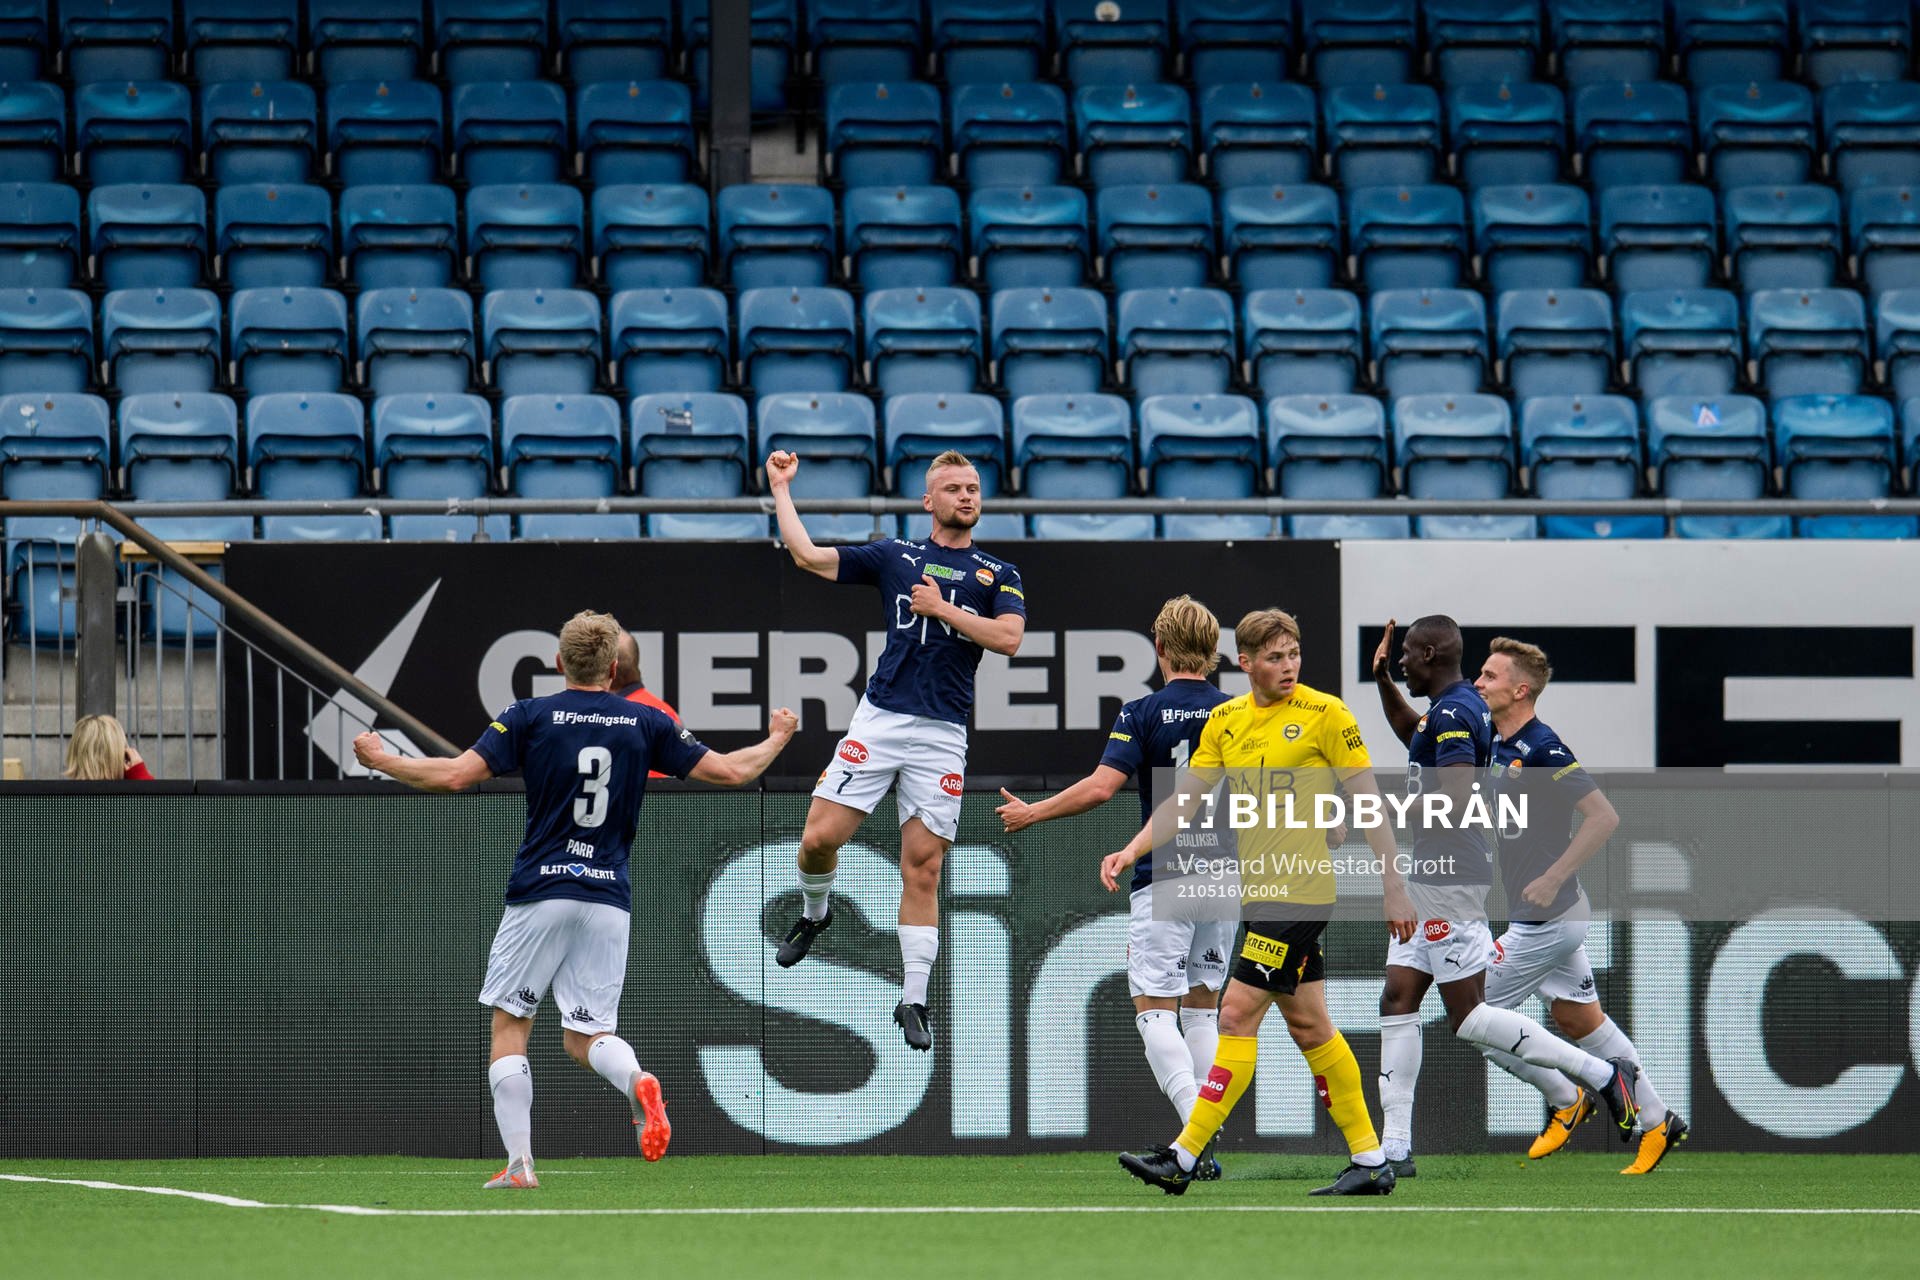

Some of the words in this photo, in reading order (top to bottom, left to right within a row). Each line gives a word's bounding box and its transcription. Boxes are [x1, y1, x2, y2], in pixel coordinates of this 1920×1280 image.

[566, 712, 637, 726] Fjerdingstad
[1174, 709, 1212, 722] Fjerdin
[573, 746, 613, 828] 3
[837, 770, 854, 794] 7
[940, 779, 963, 791] ARB
[565, 839, 595, 859] PARR
[584, 867, 616, 880] HJERTE
[1424, 921, 1451, 937] ARBO
